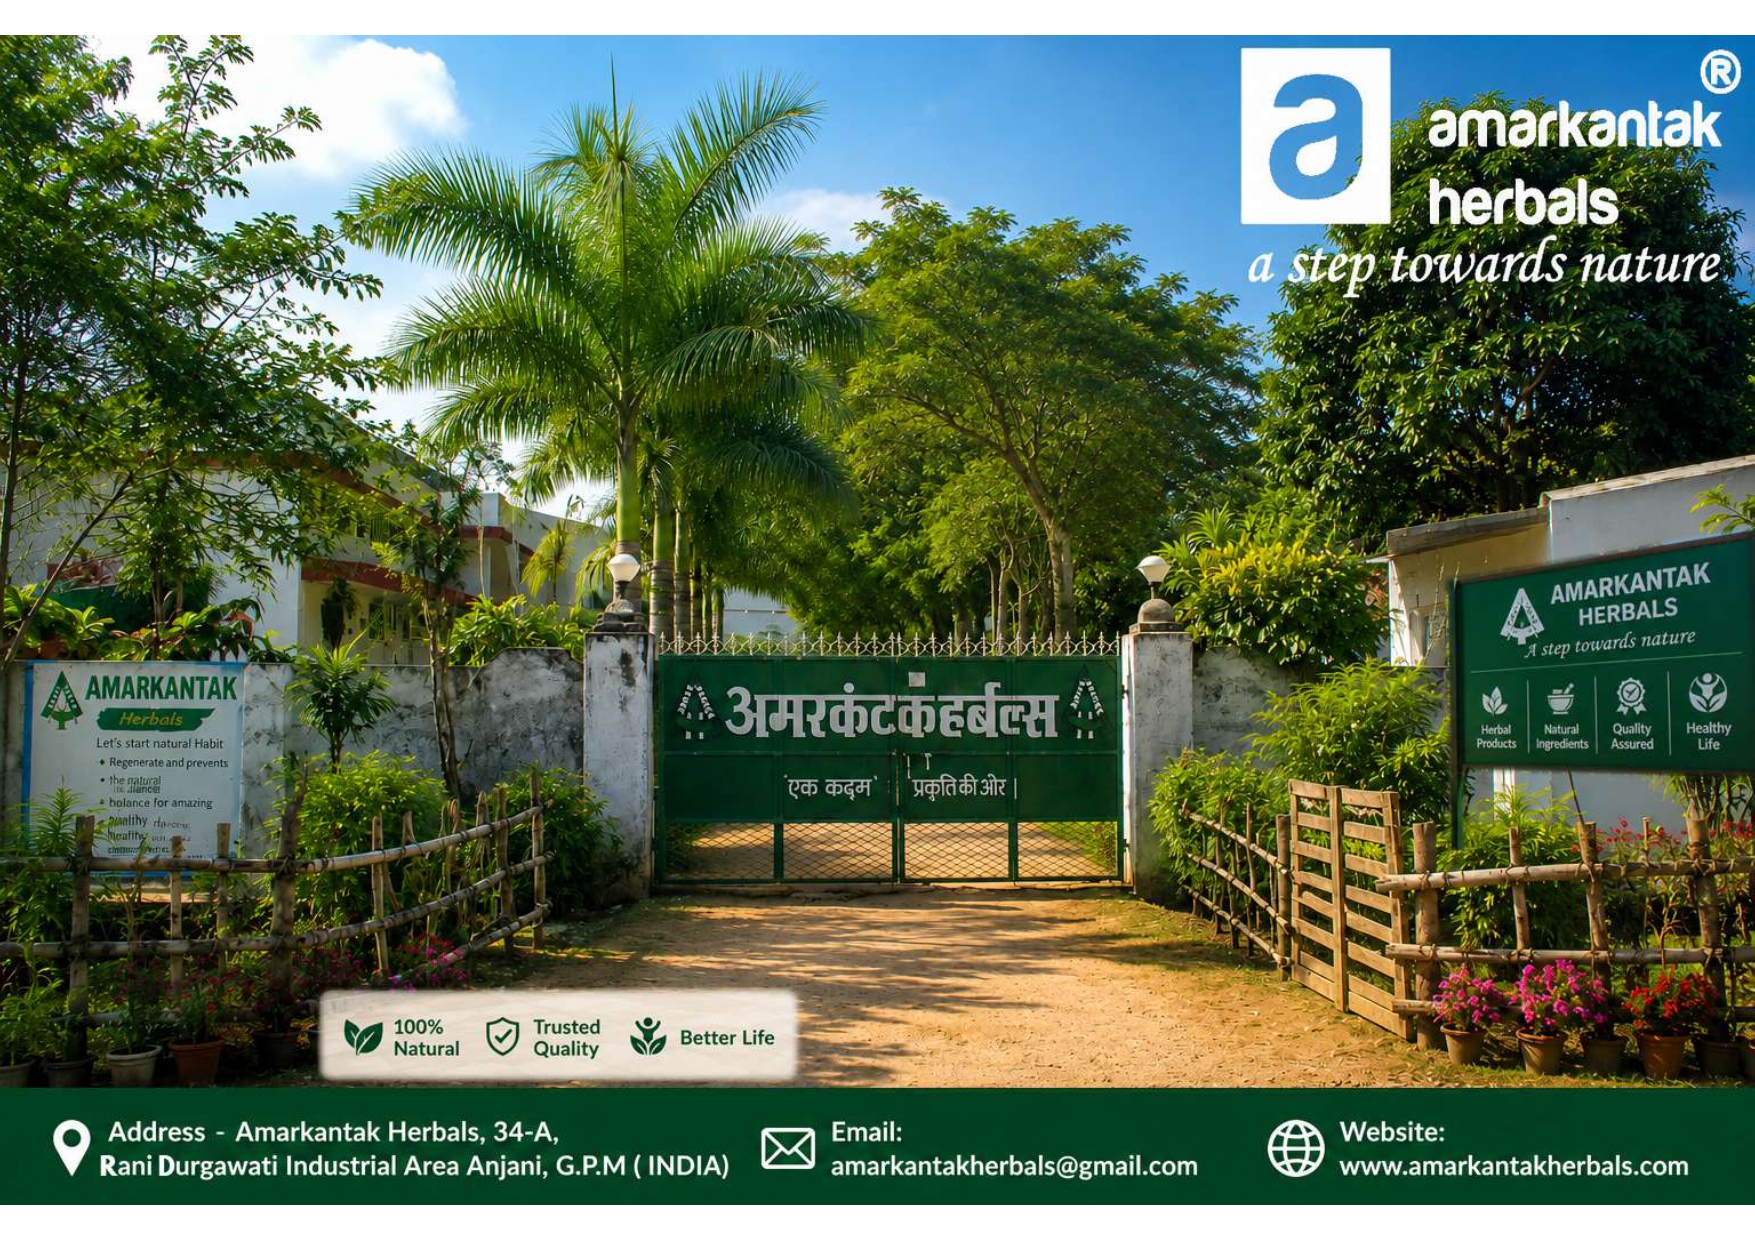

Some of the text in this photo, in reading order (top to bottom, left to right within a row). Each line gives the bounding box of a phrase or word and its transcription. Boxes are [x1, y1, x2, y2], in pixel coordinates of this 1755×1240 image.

[1551, 562, 1711, 604] AMARKANTAK
[1579, 597, 1678, 626] HERBALS
[1525, 631, 1696, 659] A step towards nature
[85, 674, 238, 701] AMARKANTAK
[119, 710, 183, 727] Herbals
[1481, 724, 1511, 735] Herbal
[1544, 723, 1580, 735] Natural
[1613, 722, 1652, 737] Quality
[1686, 721, 1732, 737] Healthy
[125, 739, 150, 749] start
[153, 738, 191, 749] natural
[195, 739, 223, 749] Habit
[1477, 738, 1517, 749] Products
[1536, 738, 1589, 752] Ingredients
[1611, 738, 1654, 750] Assured
[1698, 738, 1720, 751] Life
[109, 757, 229, 771] Regenerate and prevents
[154, 797, 169, 808] for
[172, 797, 213, 810] amazing
